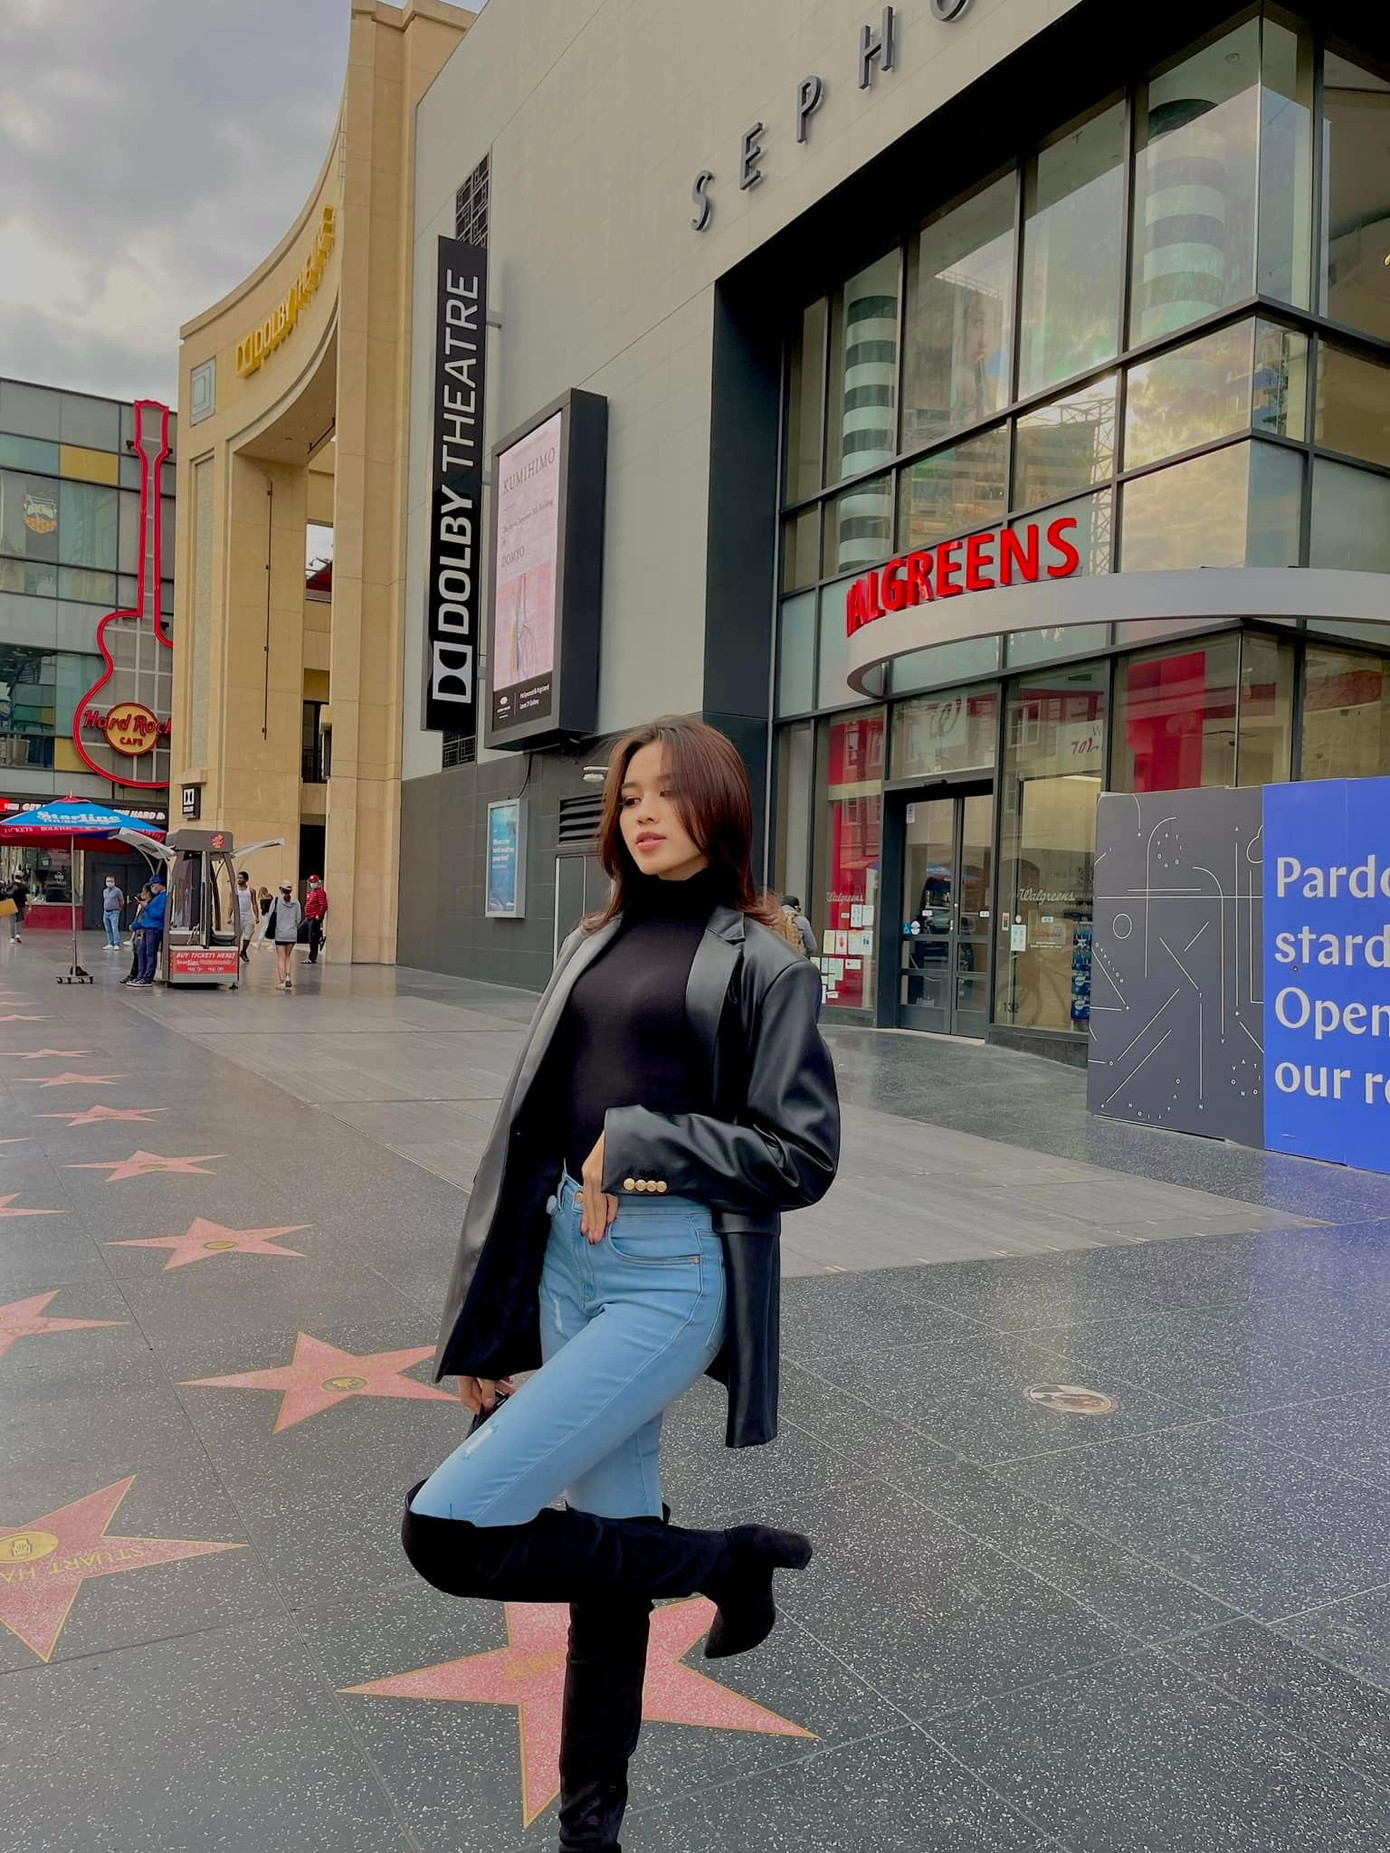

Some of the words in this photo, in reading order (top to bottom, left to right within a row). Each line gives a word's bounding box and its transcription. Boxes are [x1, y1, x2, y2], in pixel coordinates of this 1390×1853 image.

[442, 268, 479, 473] THEATRE
[503, 447, 556, 494] KUMIHIMO
[438, 484, 473, 634] DOLBY
[846, 517, 1080, 637] ALGREENS
[83, 709, 132, 731] Hard
[37, 810, 122, 823] Starline
[1019, 887, 1076, 906] Walgreens
[1274, 1062, 1351, 1100] our
[1365, 1072, 1390, 1105] r
[50, 1544, 145, 1575] STUART
